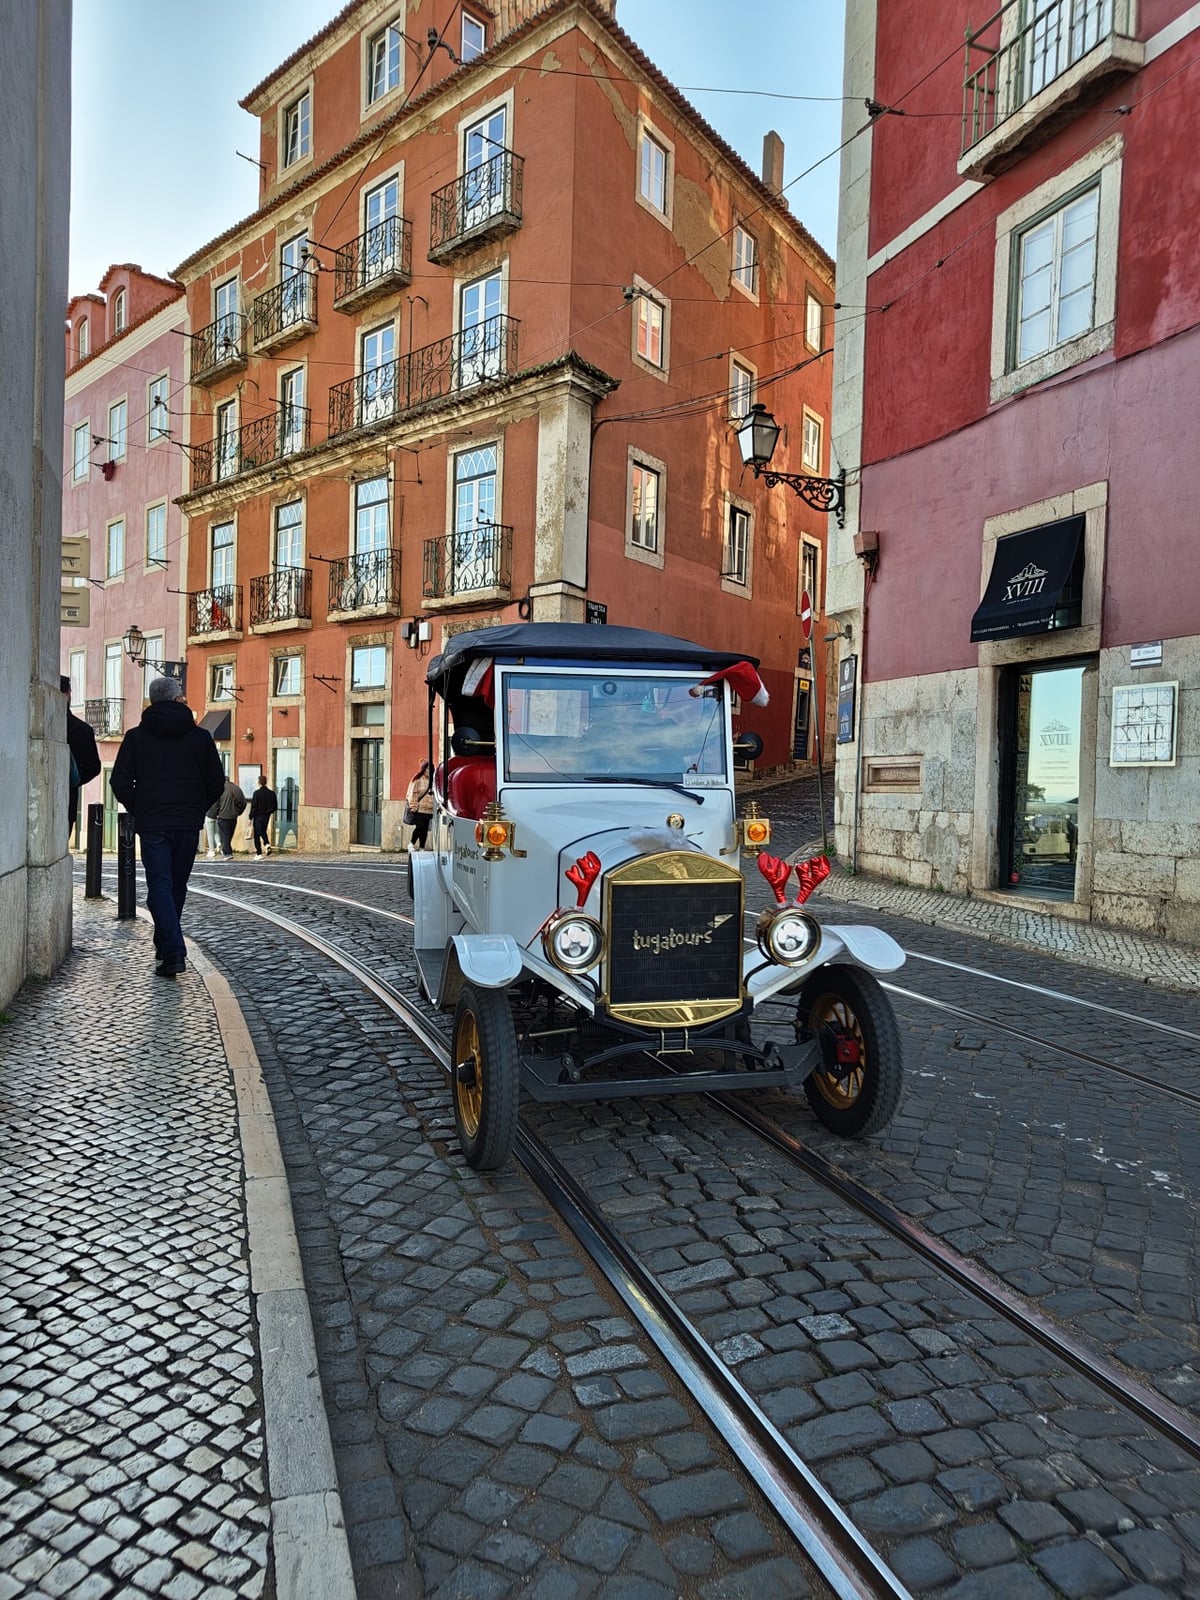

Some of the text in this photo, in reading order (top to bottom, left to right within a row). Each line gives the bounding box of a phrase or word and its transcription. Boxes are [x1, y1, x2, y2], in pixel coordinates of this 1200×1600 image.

[1001, 577, 1047, 602] XVIII
[1119, 725, 1167, 742] XVIII
[632, 927, 713, 954] tugatours
